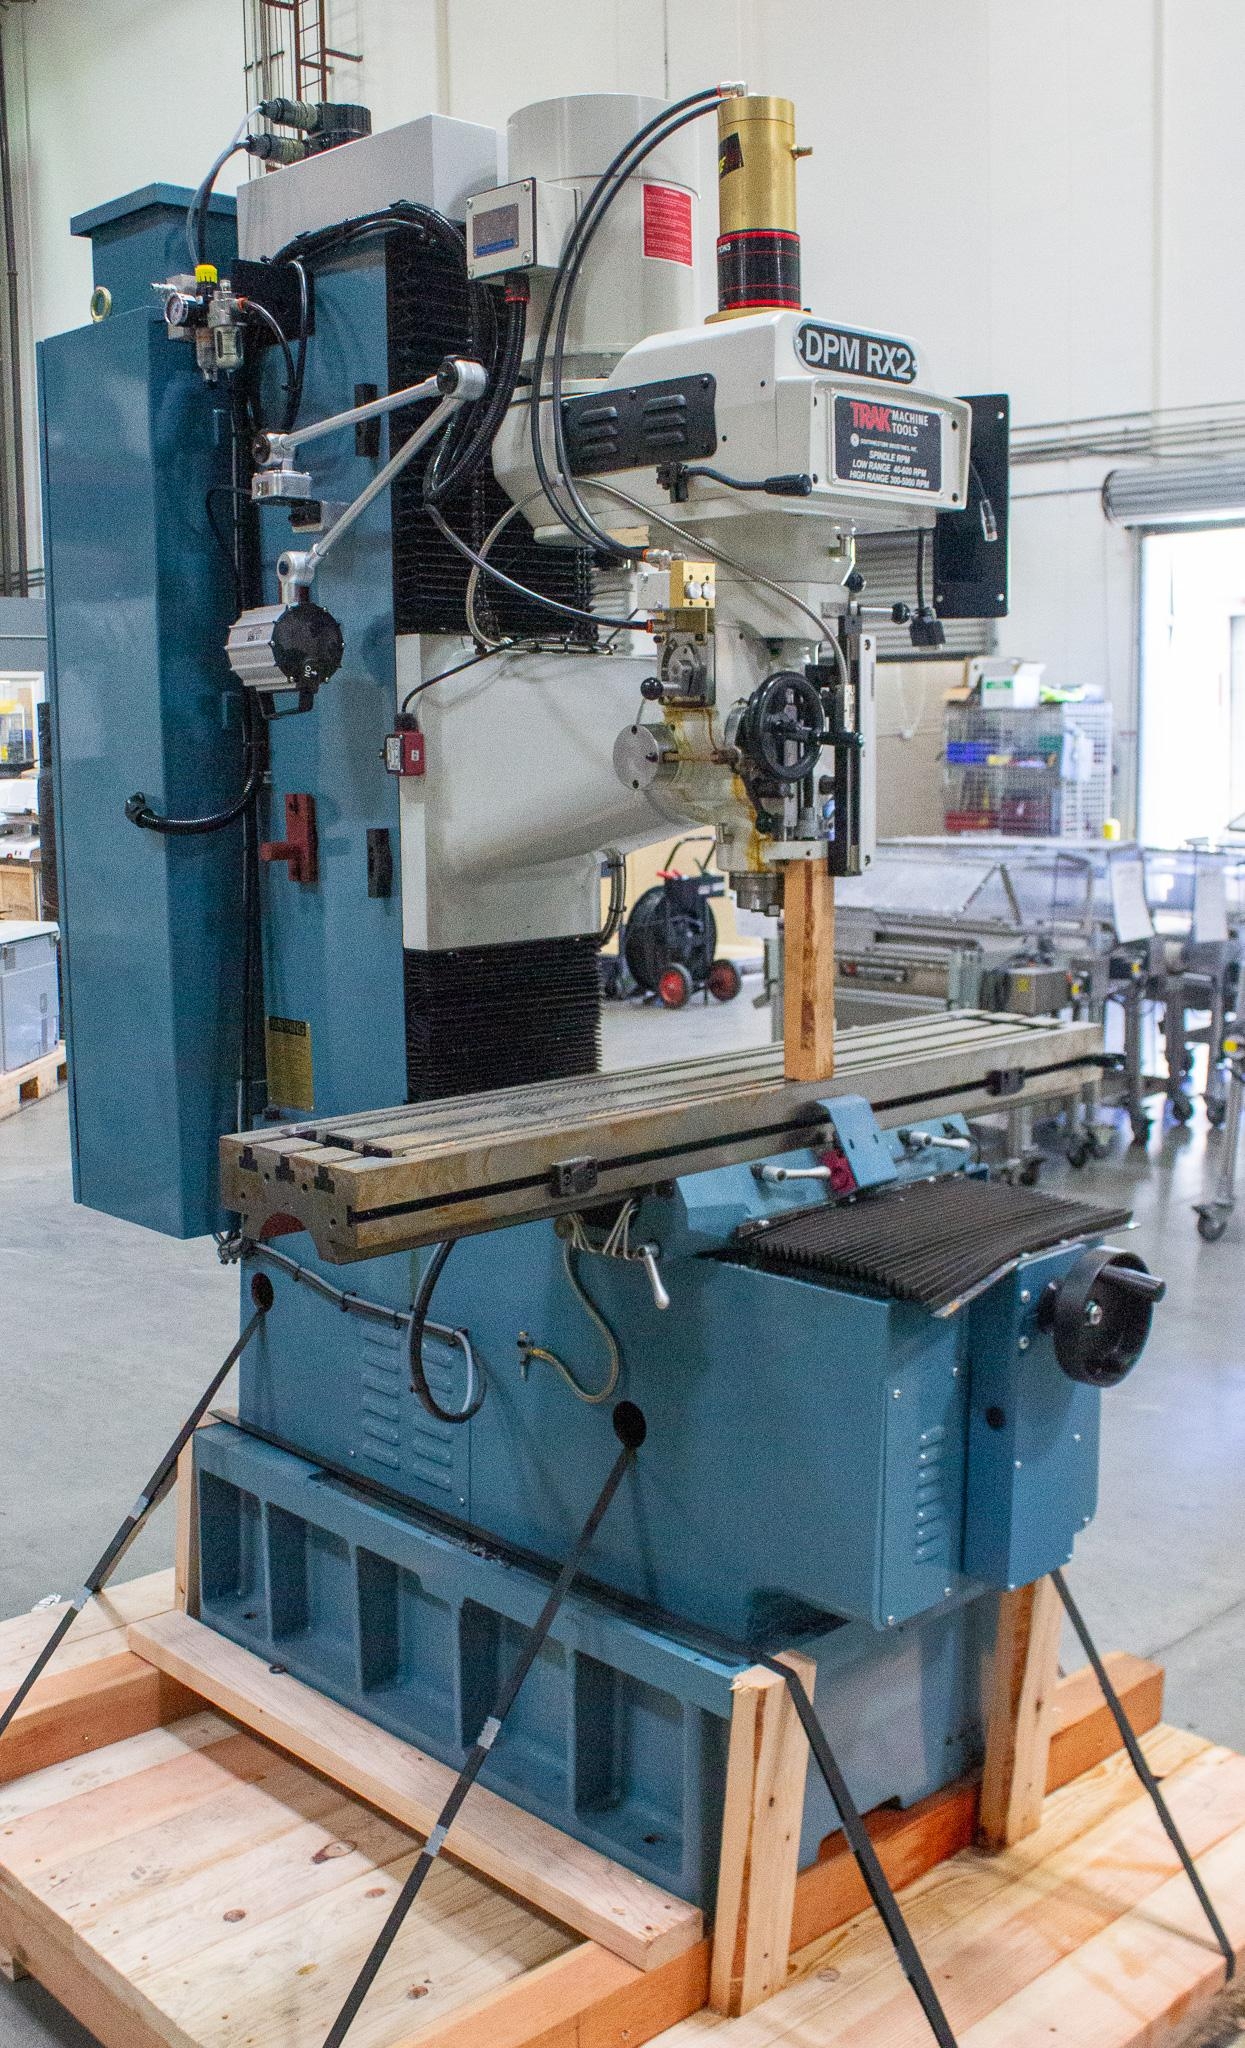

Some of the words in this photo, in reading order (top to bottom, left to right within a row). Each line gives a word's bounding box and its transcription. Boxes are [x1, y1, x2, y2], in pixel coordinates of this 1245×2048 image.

[805, 329, 860, 370] DPM
[866, 340, 911, 380] RX2
[849, 401, 892, 433] TRAK
[892, 410, 929, 427] MACHINE
[891, 422, 919, 437] TOOLS
[868, 450, 896, 462] SPINDLE
[896, 454, 911, 464] RPM
[852, 459, 868, 468] LOW
[868, 462, 891, 472] RANGE
[913, 467, 927, 478] RPM
[849, 470, 866, 480] HIGH
[866, 473, 889, 483] RANGE
[916, 479, 930, 489] RPM
